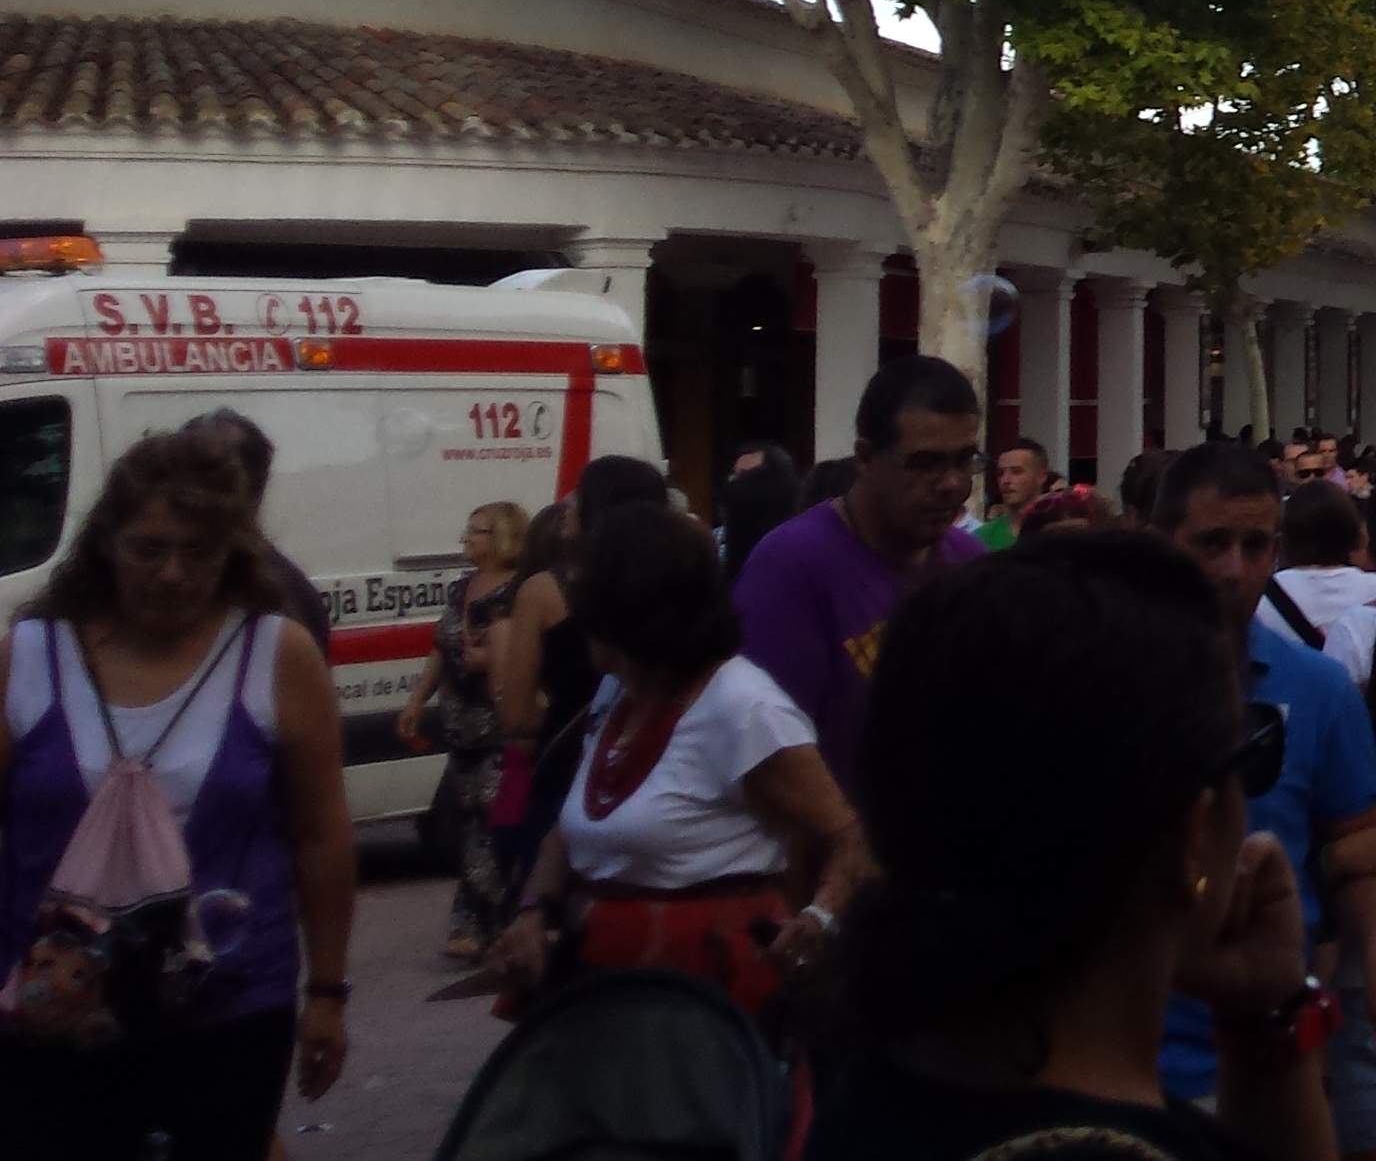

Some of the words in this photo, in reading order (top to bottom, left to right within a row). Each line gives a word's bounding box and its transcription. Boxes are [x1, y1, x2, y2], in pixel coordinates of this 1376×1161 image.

[298, 295, 363, 335] 112
[62, 341, 284, 374] AMBULANCIA
[468, 401, 523, 439] 112
[373, 677, 393, 696] de
